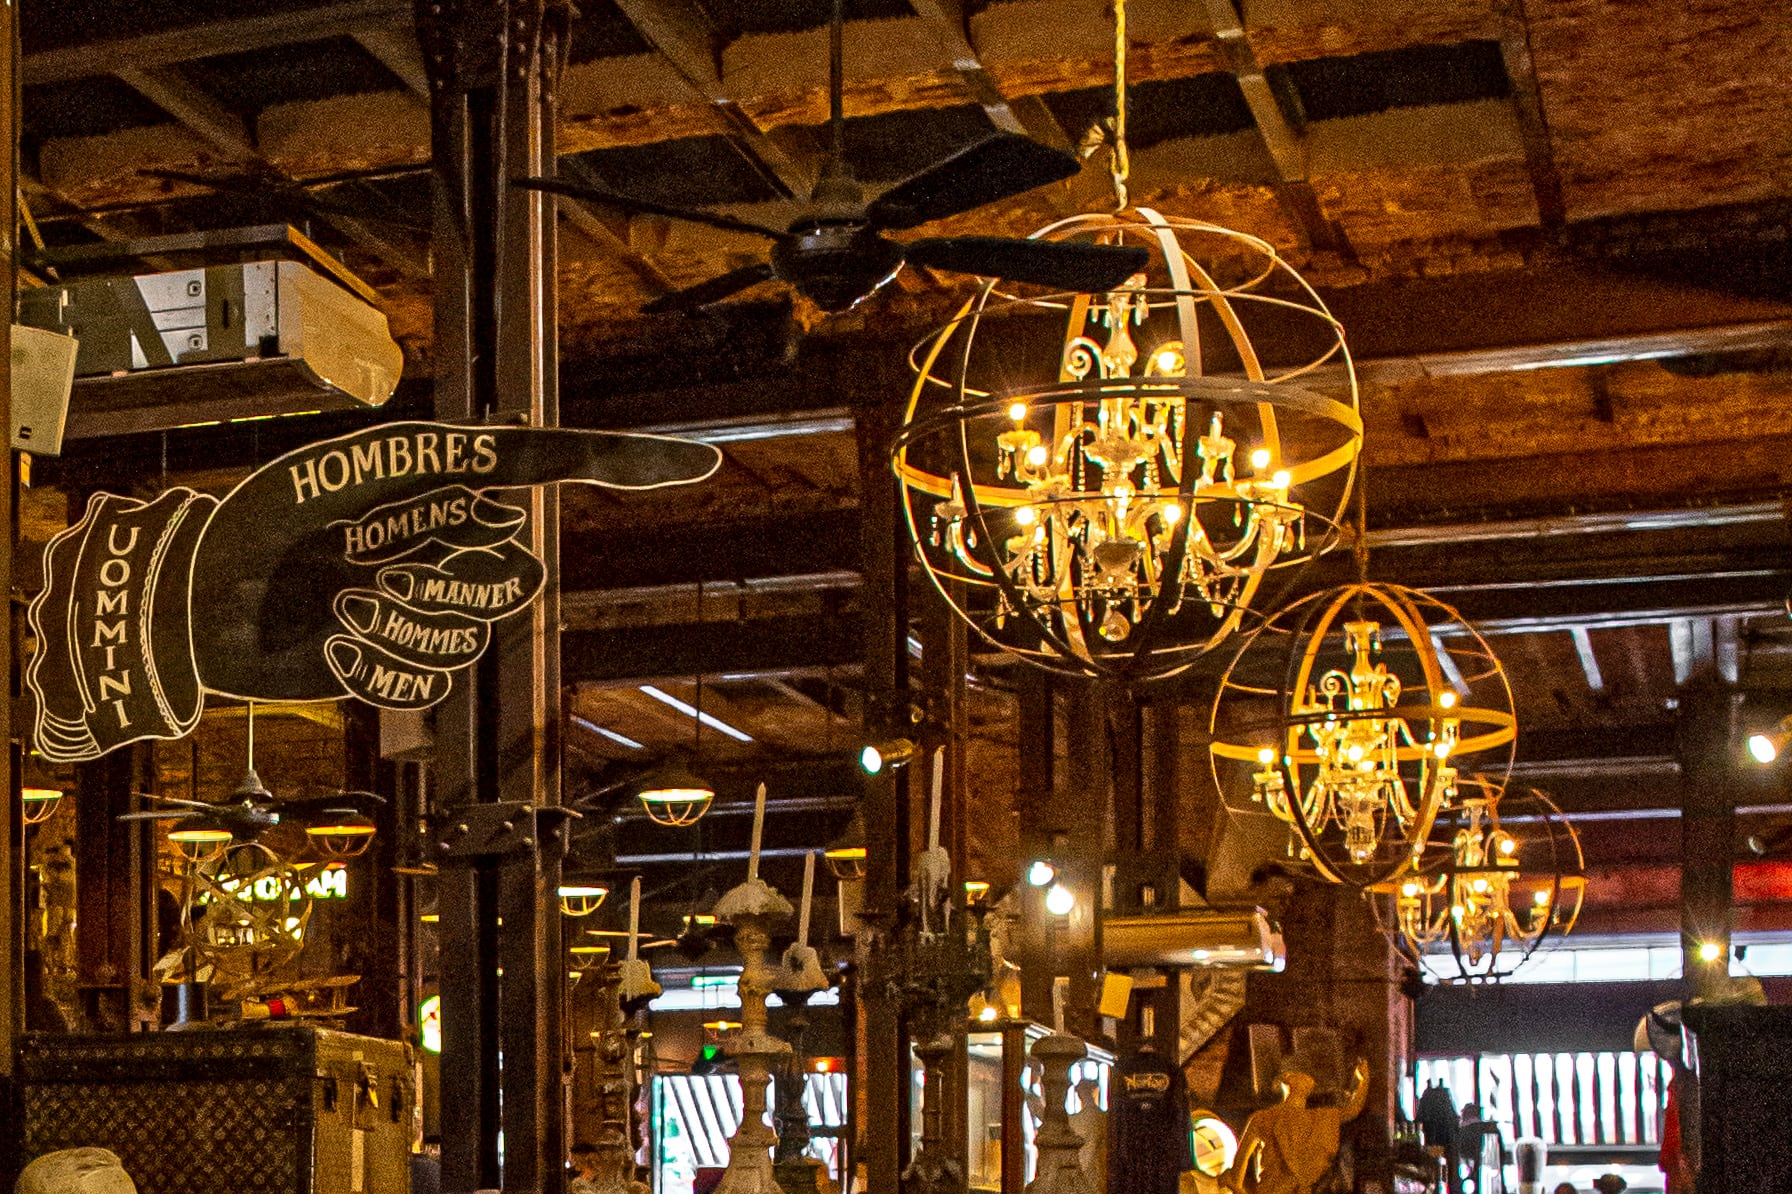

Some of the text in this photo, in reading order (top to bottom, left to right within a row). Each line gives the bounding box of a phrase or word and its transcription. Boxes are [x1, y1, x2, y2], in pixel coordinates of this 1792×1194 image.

[289, 433, 498, 504] HOMBRES
[345, 497, 468, 554] HOMENS
[423, 576, 525, 609] MANNER
[91, 523, 142, 728] UOMMINI
[382, 610, 479, 655] HOMMES
[367, 664, 435, 701] MEN
